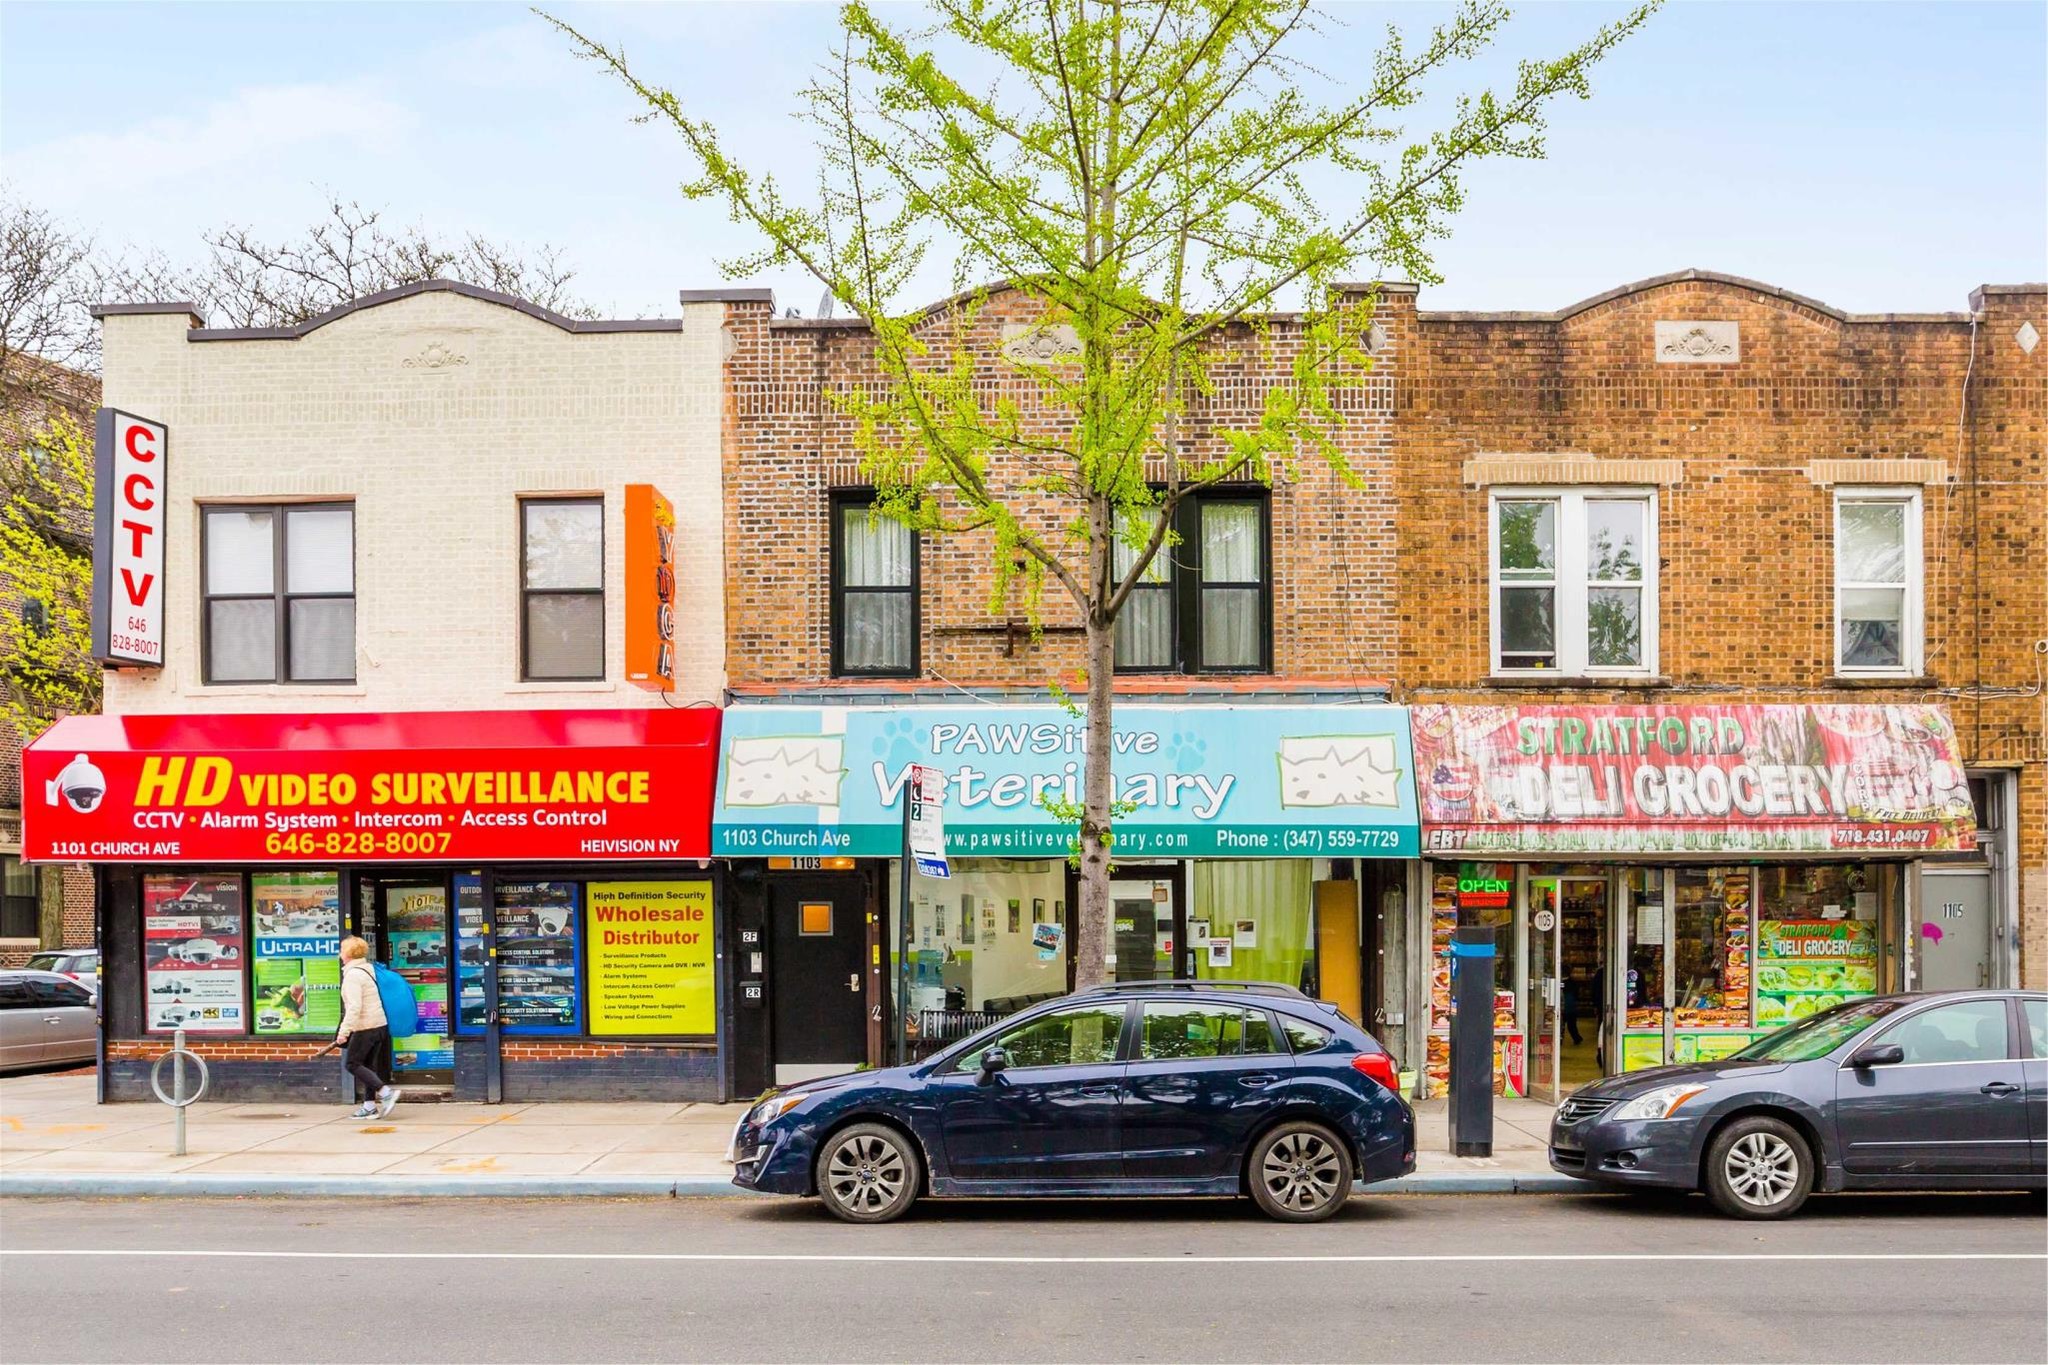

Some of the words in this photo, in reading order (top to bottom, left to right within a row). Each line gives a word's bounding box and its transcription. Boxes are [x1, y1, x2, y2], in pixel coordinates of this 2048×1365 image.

[120, 425, 156, 607] CCTV
[128, 616, 146, 633] 646
[112, 635, 158, 656] 828-8007
[930, 722, 1160, 754] PAWSitve
[1516, 716, 1745, 756] STRATFORD
[134, 756, 233, 807] HD
[240, 773, 357, 807] VIDEO
[371, 771, 649, 805] SURVEILLANCE
[1852, 763, 1871, 812] CORP
[872, 760, 1236, 821] Vteriary
[1518, 765, 1624, 817] DELI
[1632, 764, 1848, 817] GROCERY
[133, 811, 184, 828] CCTV
[201, 811, 259, 828] Alarm
[265, 812, 337, 832] System
[355, 810, 442, 827] Intercom
[461, 809, 528, 826] Access
[533, 808, 607, 825] Control
[266, 832, 452, 854] 646-828-8007
[723, 829, 756, 846] 1103
[761, 828, 816, 846] Church
[821, 829, 850, 846] Ave
[1217, 830, 1269, 847] Phone
[1283, 830, 1323, 850] (347)
[1328, 830, 1399, 847] 559-7729
[1427, 829, 1468, 849] EBT
[1837, 828, 1930, 844] 718.431.0407
[51, 841, 87, 855] 1101
[91, 841, 149, 855] CHURCH
[152, 841, 180, 855] AVE
[581, 839, 655, 853] HEIVISION
[658, 838, 680, 852] NY
[792, 857, 821, 868] 1103
[1460, 880, 1508, 892] OPEN
[618, 891, 663, 900] Definition
[666, 891, 706, 901] Security
[595, 905, 704, 922] Wholesale
[1943, 903, 1964, 918] 1105
[603, 930, 699, 945] Distributor
[744, 932, 756, 941] 2F
[1780, 924, 1831, 938] STRATFORD
[1778, 939, 1801, 955] DELI
[1804, 939, 1852, 955] GROCERY
[748, 989, 760, 997] 2R
